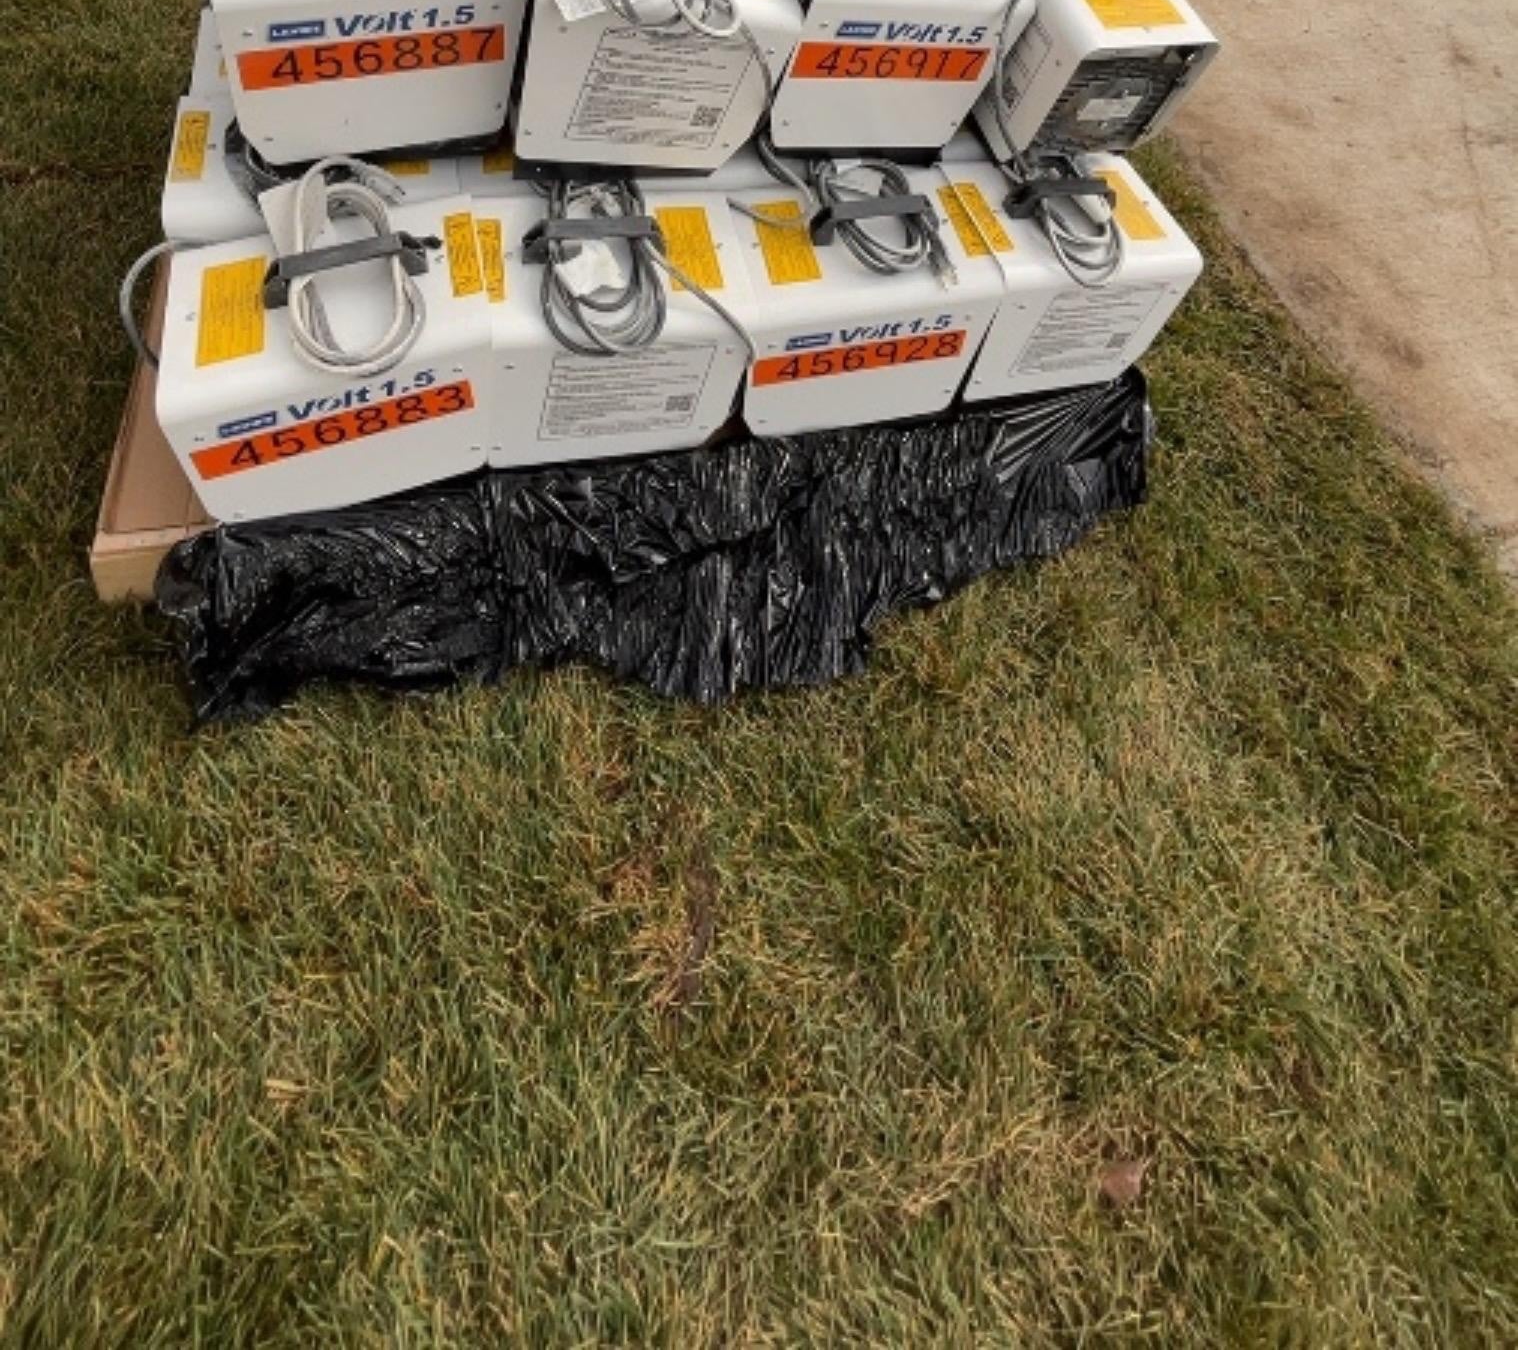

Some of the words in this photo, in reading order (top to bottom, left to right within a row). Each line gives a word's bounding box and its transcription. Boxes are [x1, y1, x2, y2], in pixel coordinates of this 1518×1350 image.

[334, 10, 415, 37] Volt
[422, 4, 475, 27] 1.5
[887, 22, 942, 43] Volt
[947, 26, 987, 43] 1.5
[271, 28, 496, 83] 456887
[815, 46, 983, 79] 456917
[909, 314, 952, 332] 1.5
[777, 332, 959, 379] 456928
[287, 386, 370, 421] Volt
[381, 369, 436, 396] 1.5
[230, 385, 467, 466] 456883
